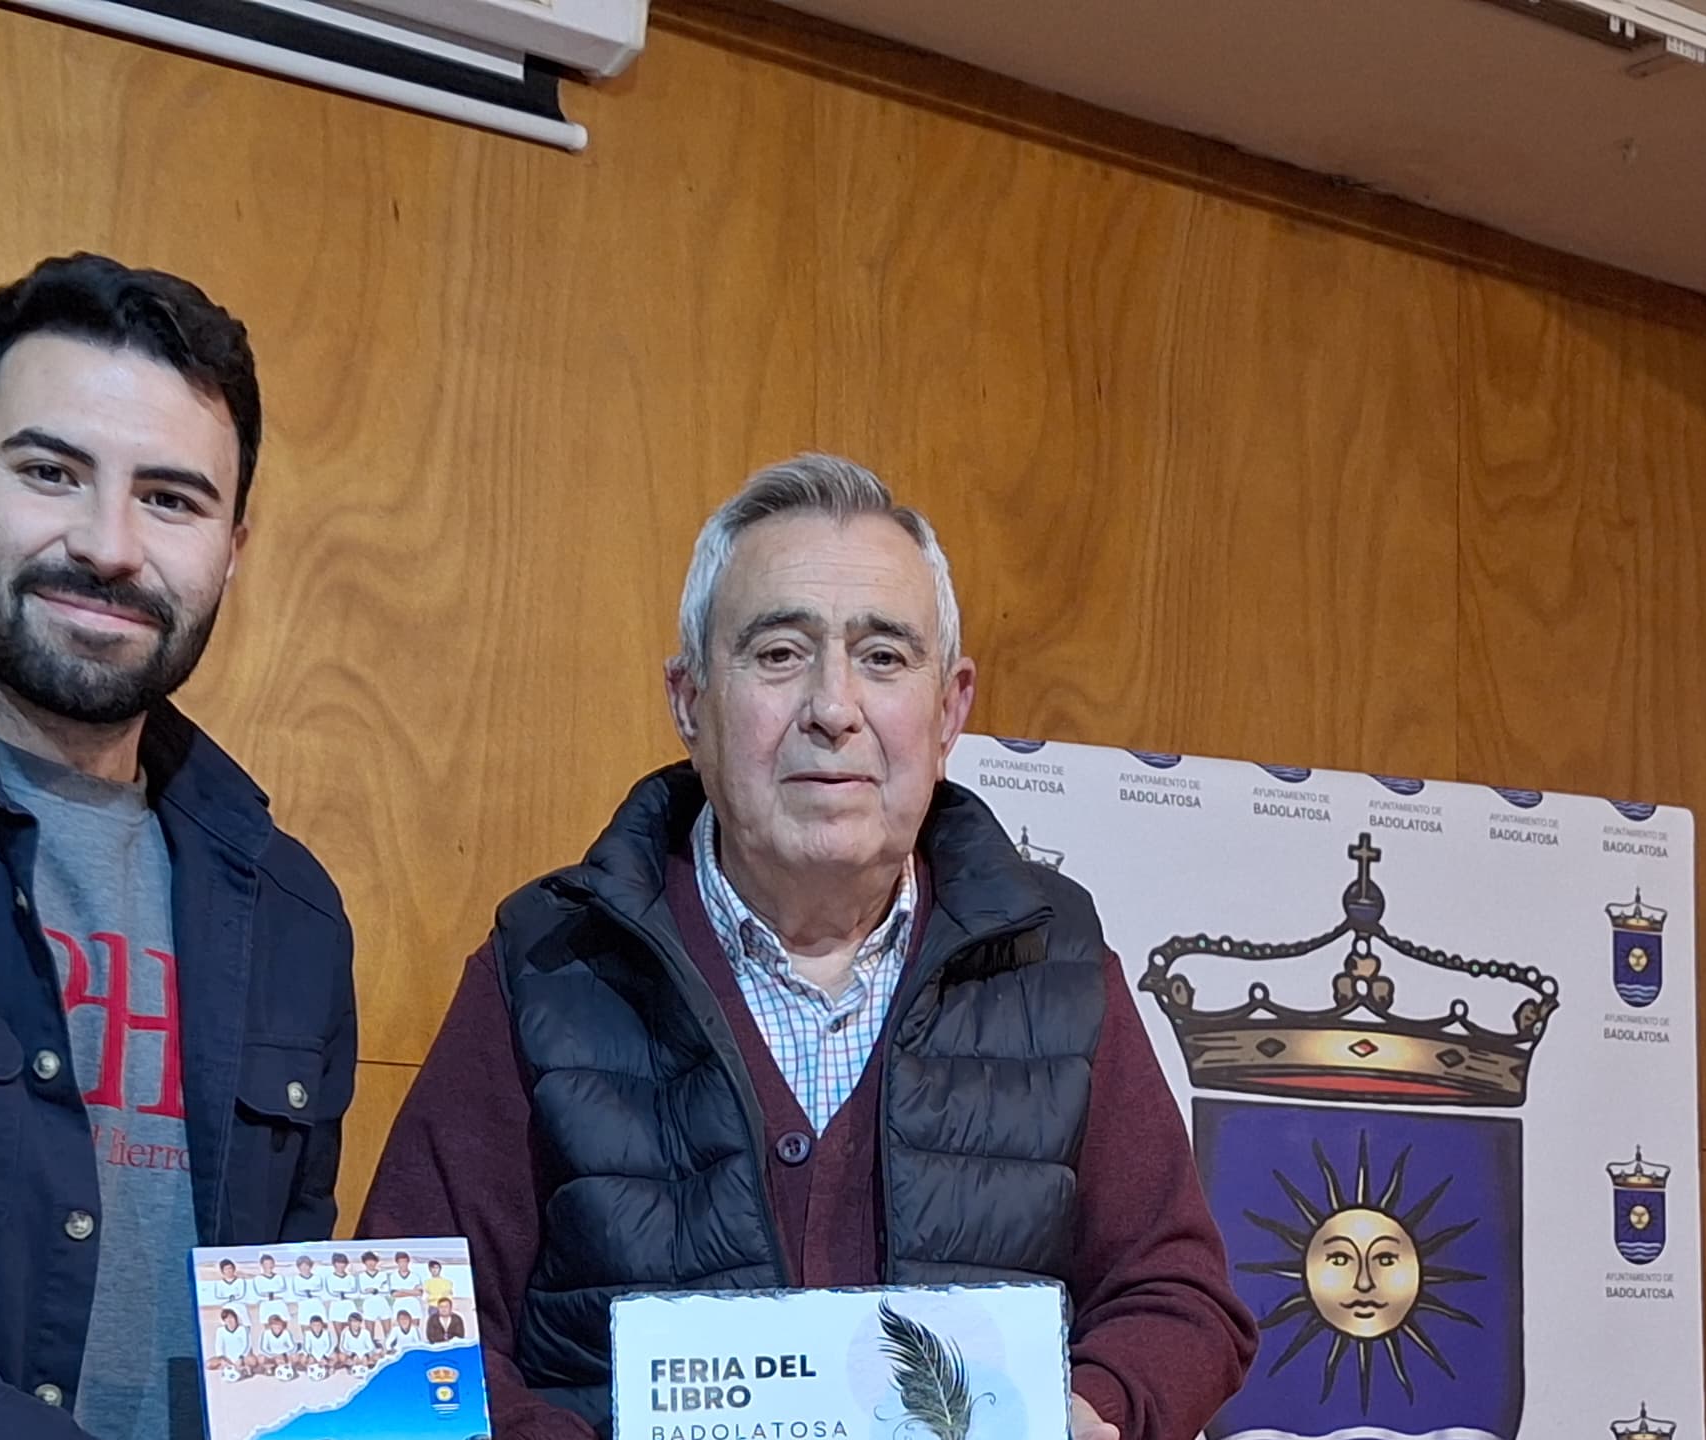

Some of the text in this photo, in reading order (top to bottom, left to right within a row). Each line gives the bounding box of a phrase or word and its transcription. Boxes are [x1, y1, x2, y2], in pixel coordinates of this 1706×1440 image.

[979, 756, 1065, 776] AYUNTAMIENTO DE
[979, 774, 1065, 794] BADOLATOSA
[1119, 772, 1187, 788] AYUNTAMIENTO
[1119, 789, 1202, 808] BADOLATOSA
[1252, 786, 1314, 803] AYUNTAMIENTO
[1252, 802, 1331, 822] BADOLATOSA
[1369, 799, 1429, 815] AYUNTAMIENTO
[1369, 815, 1443, 834] BADOLATOSA
[1489, 827, 1559, 846] BADOLATOSA
[1603, 840, 1669, 858] BADOLATOSA
[1604, 1027, 1669, 1042] BADOLATOSA
[1605, 1287, 1675, 1299] BADOLATOSA
[651, 1354, 817, 1384] FERIA DEL
[651, 1385, 751, 1412] LIBRO
